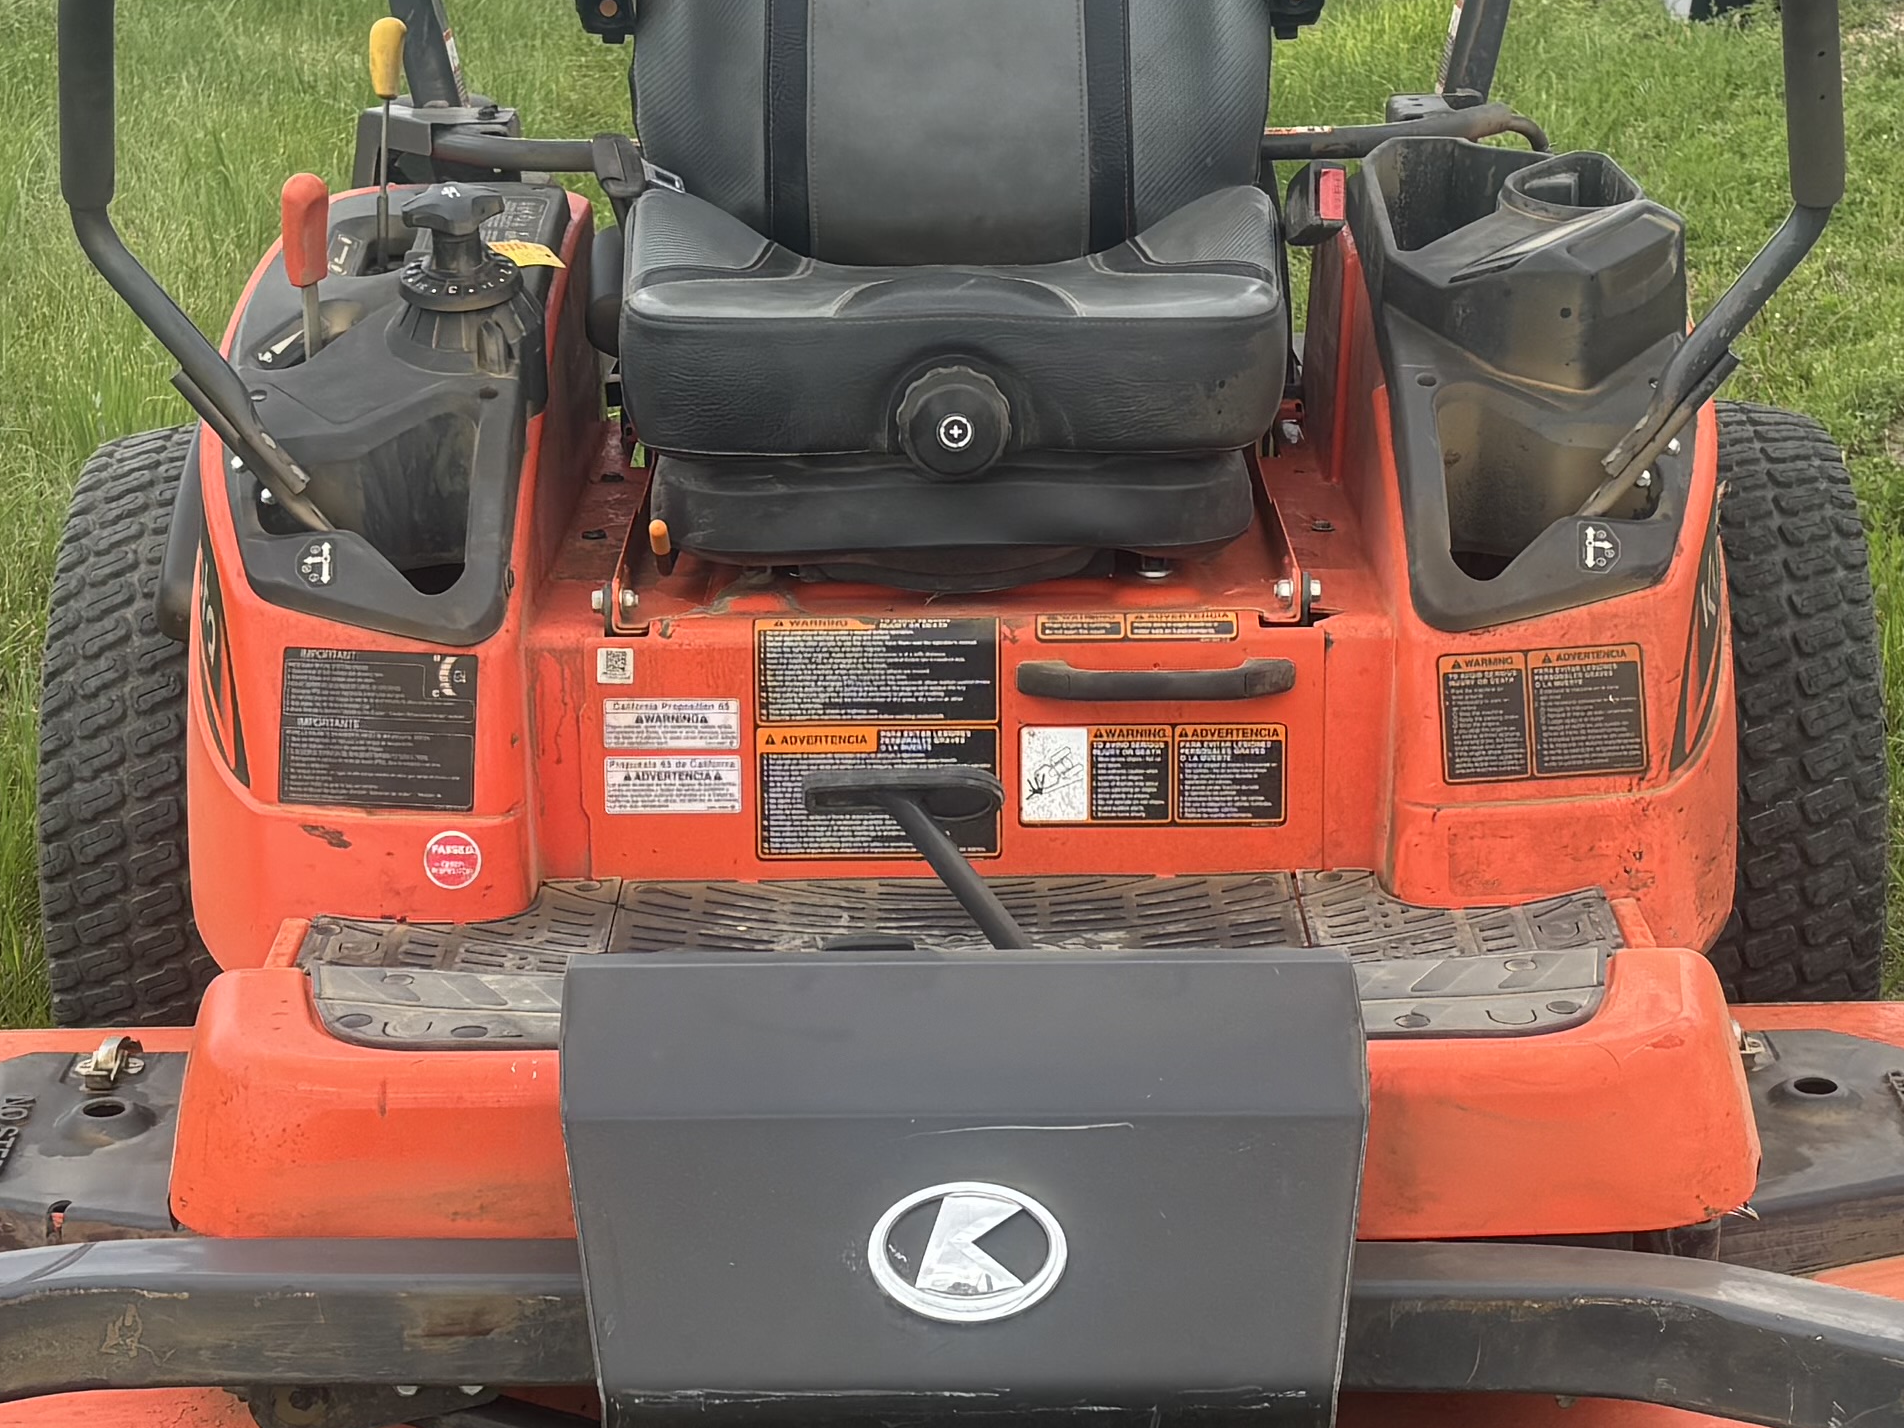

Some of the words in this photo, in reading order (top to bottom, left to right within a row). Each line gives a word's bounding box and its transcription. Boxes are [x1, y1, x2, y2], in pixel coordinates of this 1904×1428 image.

[1556, 649, 1627, 662] ADVERTENCIA
[1464, 656, 1513, 668] WARNING
[1105, 729, 1167, 739] WARNING
[1191, 728, 1280, 739] ADVERTENCIA
[781, 734, 868, 746] ADVERTENCIA
[635, 771, 712, 782] ADVERTENCIA
